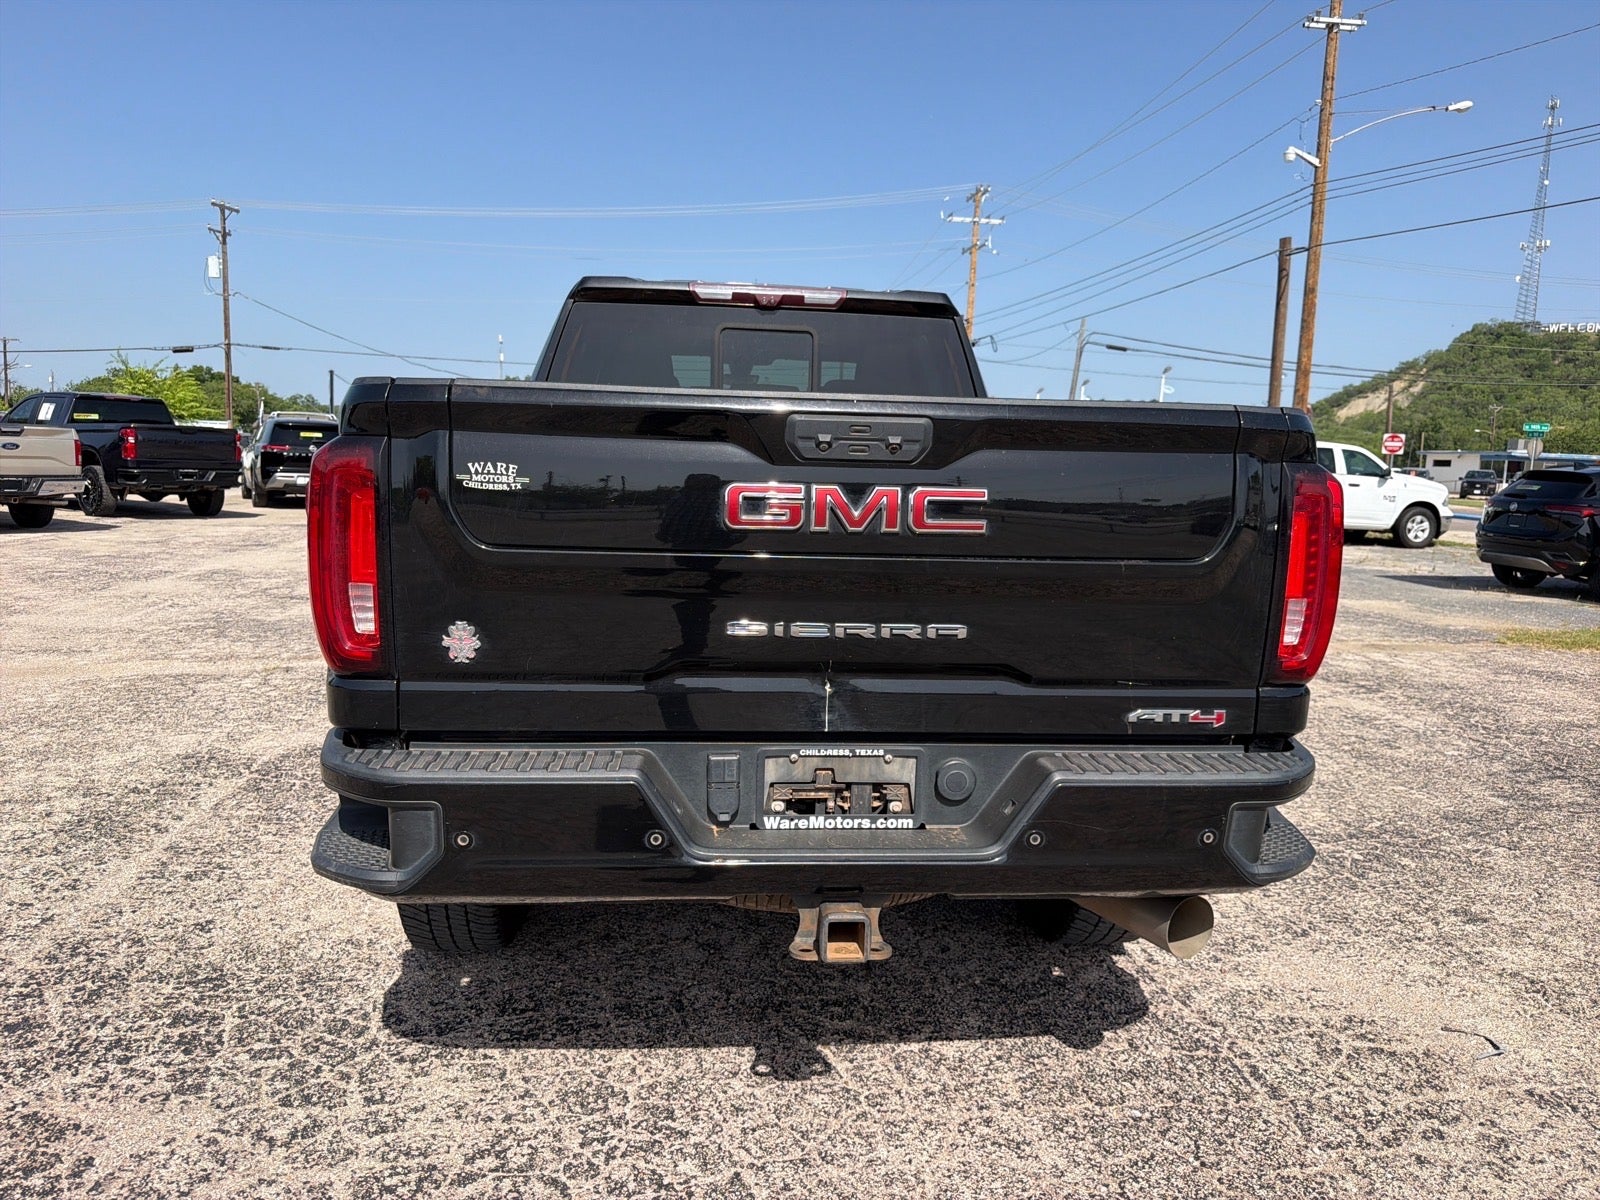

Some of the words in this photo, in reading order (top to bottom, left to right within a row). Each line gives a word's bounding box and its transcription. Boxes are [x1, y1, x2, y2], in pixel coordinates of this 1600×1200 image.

[467, 462, 518, 477] WARE
[462, 480, 509, 491] CHILDRESS,
[471, 474, 514, 483] MOTORS
[725, 482, 988, 534] GMC
[726, 619, 968, 640] SIERRA
[1127, 709, 1226, 728] AT4
[800, 749, 853, 757] CHILDRESS,
[763, 816, 914, 830] WareMotors.com
